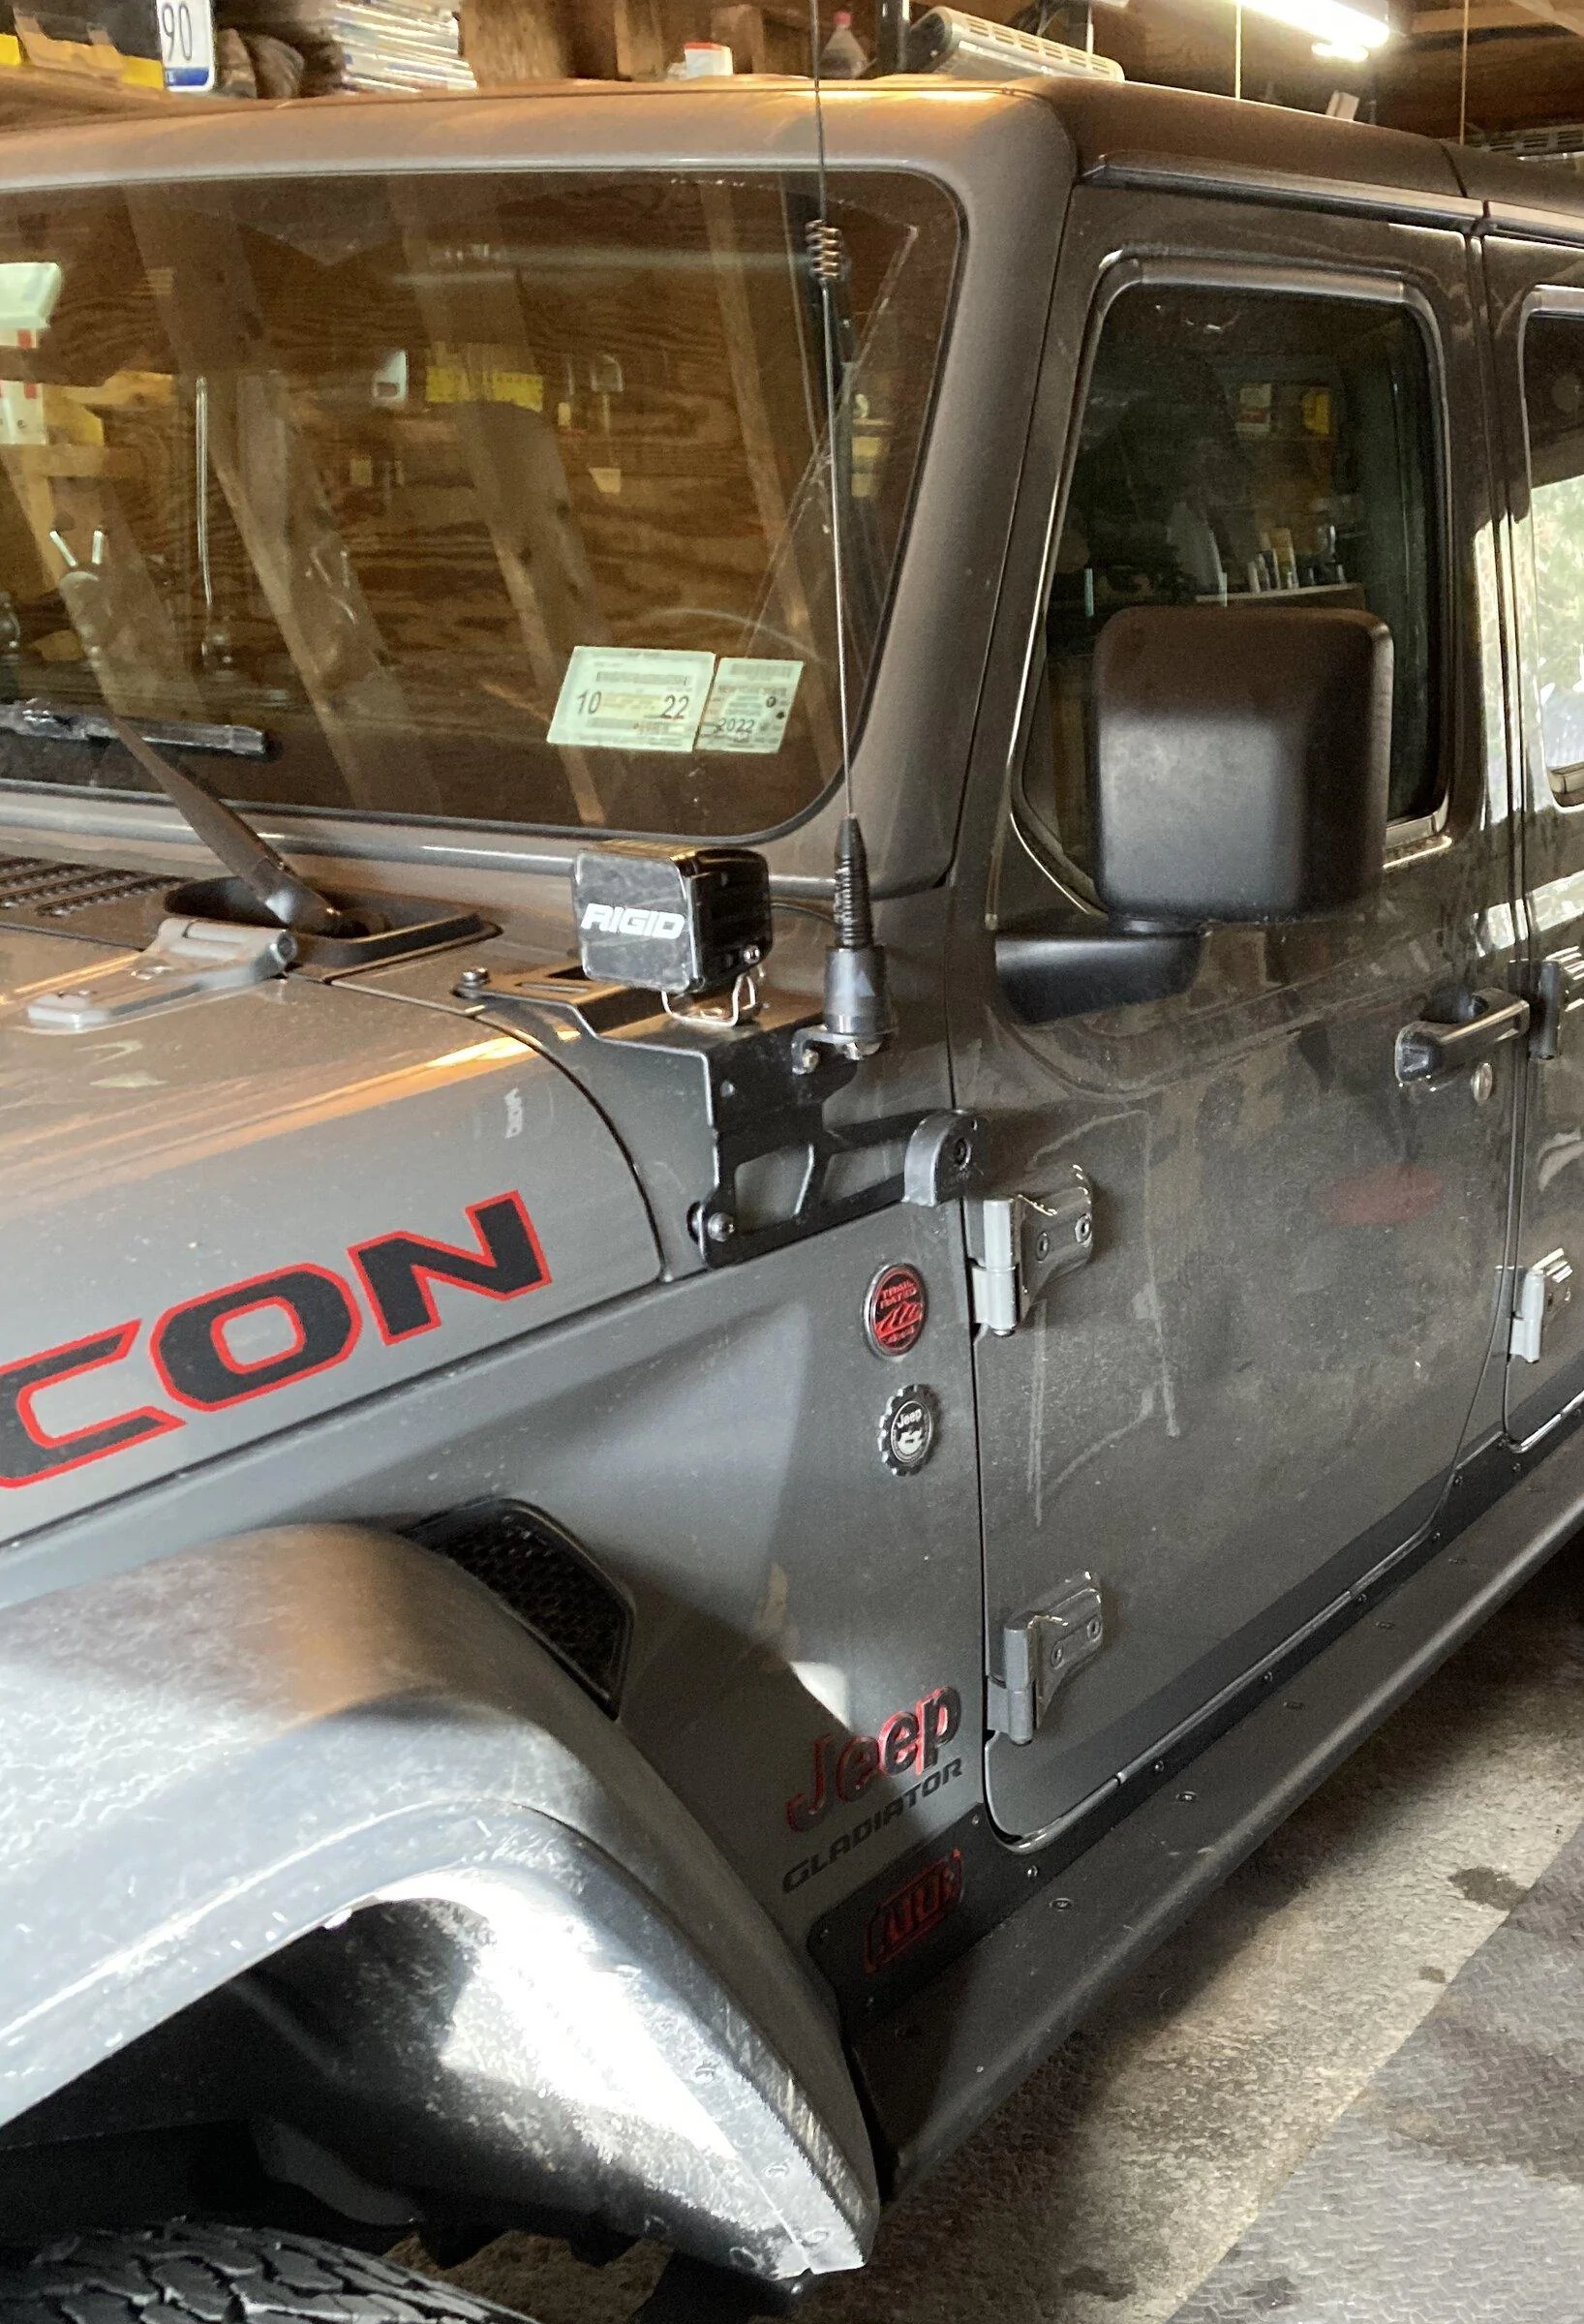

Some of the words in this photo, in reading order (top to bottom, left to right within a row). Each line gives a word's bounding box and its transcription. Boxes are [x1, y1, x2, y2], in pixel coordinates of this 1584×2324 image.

[162, 3, 193, 61] 90
[577, 690, 602, 715] 10
[661, 693, 689, 719] 22
[716, 717, 755, 734] 2022
[581, 902, 685, 939] RIGID
[0, 1190, 552, 1488] CON
[897, 1408, 922, 1429] Jeep
[786, 1686, 961, 1832] Jeep
[782, 1758, 962, 1894] GLADIATOR
